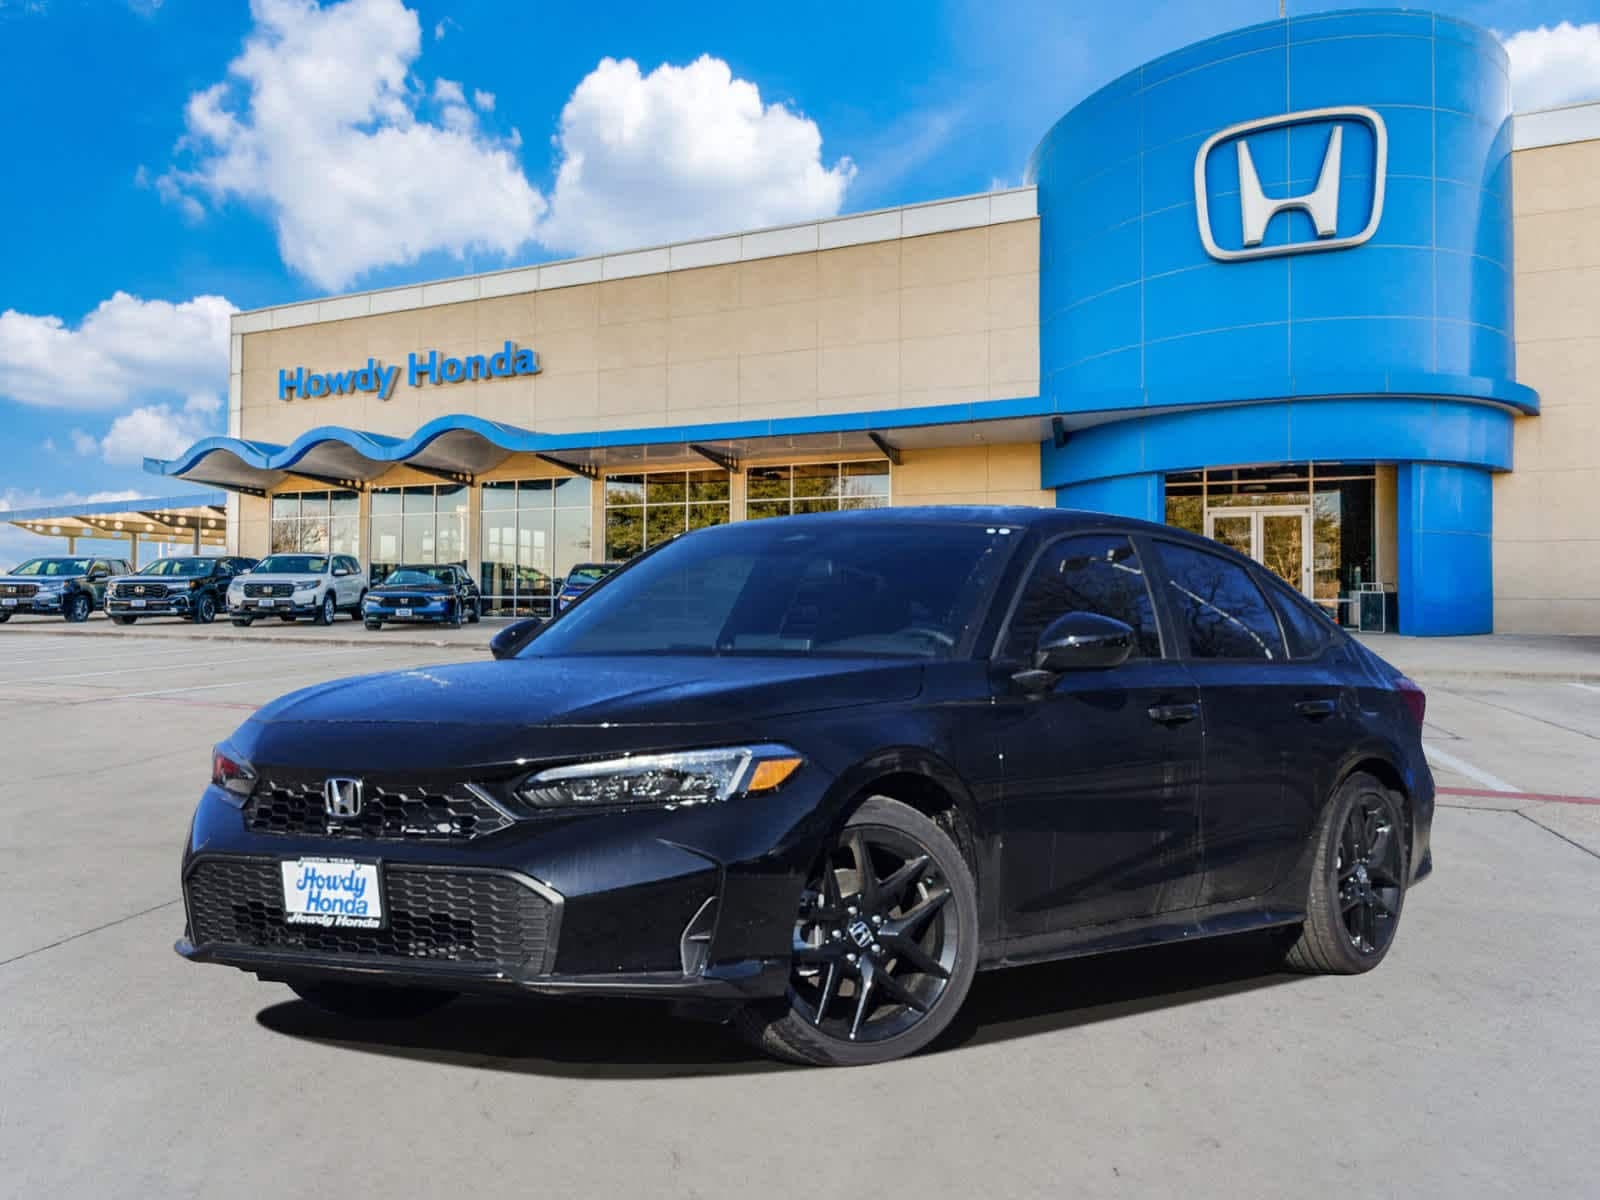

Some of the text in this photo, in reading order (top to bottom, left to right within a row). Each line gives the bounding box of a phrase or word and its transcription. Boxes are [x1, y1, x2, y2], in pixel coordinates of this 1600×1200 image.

[279, 341, 539, 401] Howdy Honda
[296, 867, 366, 897] Howdy
[306, 890, 368, 915] Honda
[287, 912, 380, 928] Howdy Honda
